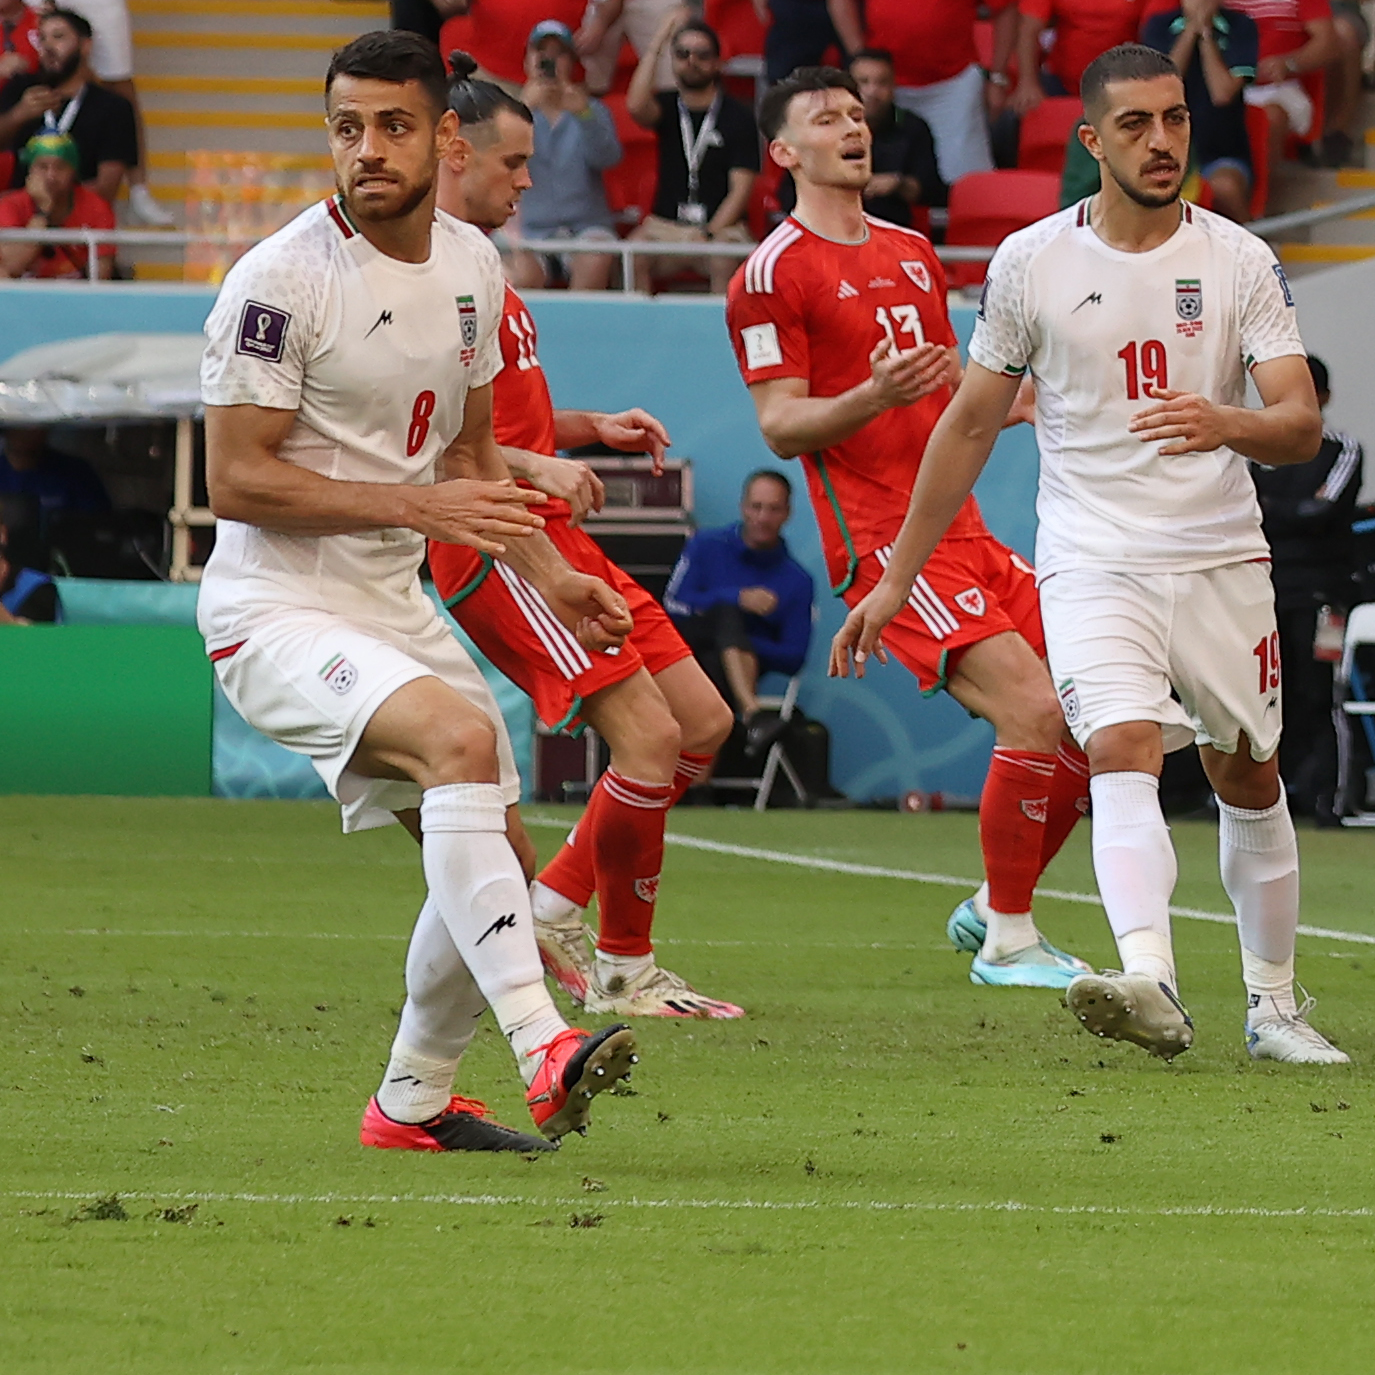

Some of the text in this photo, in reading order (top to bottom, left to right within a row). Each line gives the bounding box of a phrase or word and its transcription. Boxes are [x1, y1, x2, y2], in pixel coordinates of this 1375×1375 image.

[874, 303, 927, 361] 13
[1116, 338, 1169, 401] 19
[406, 389, 437, 458] 8
[1252, 629, 1281, 695] 19
